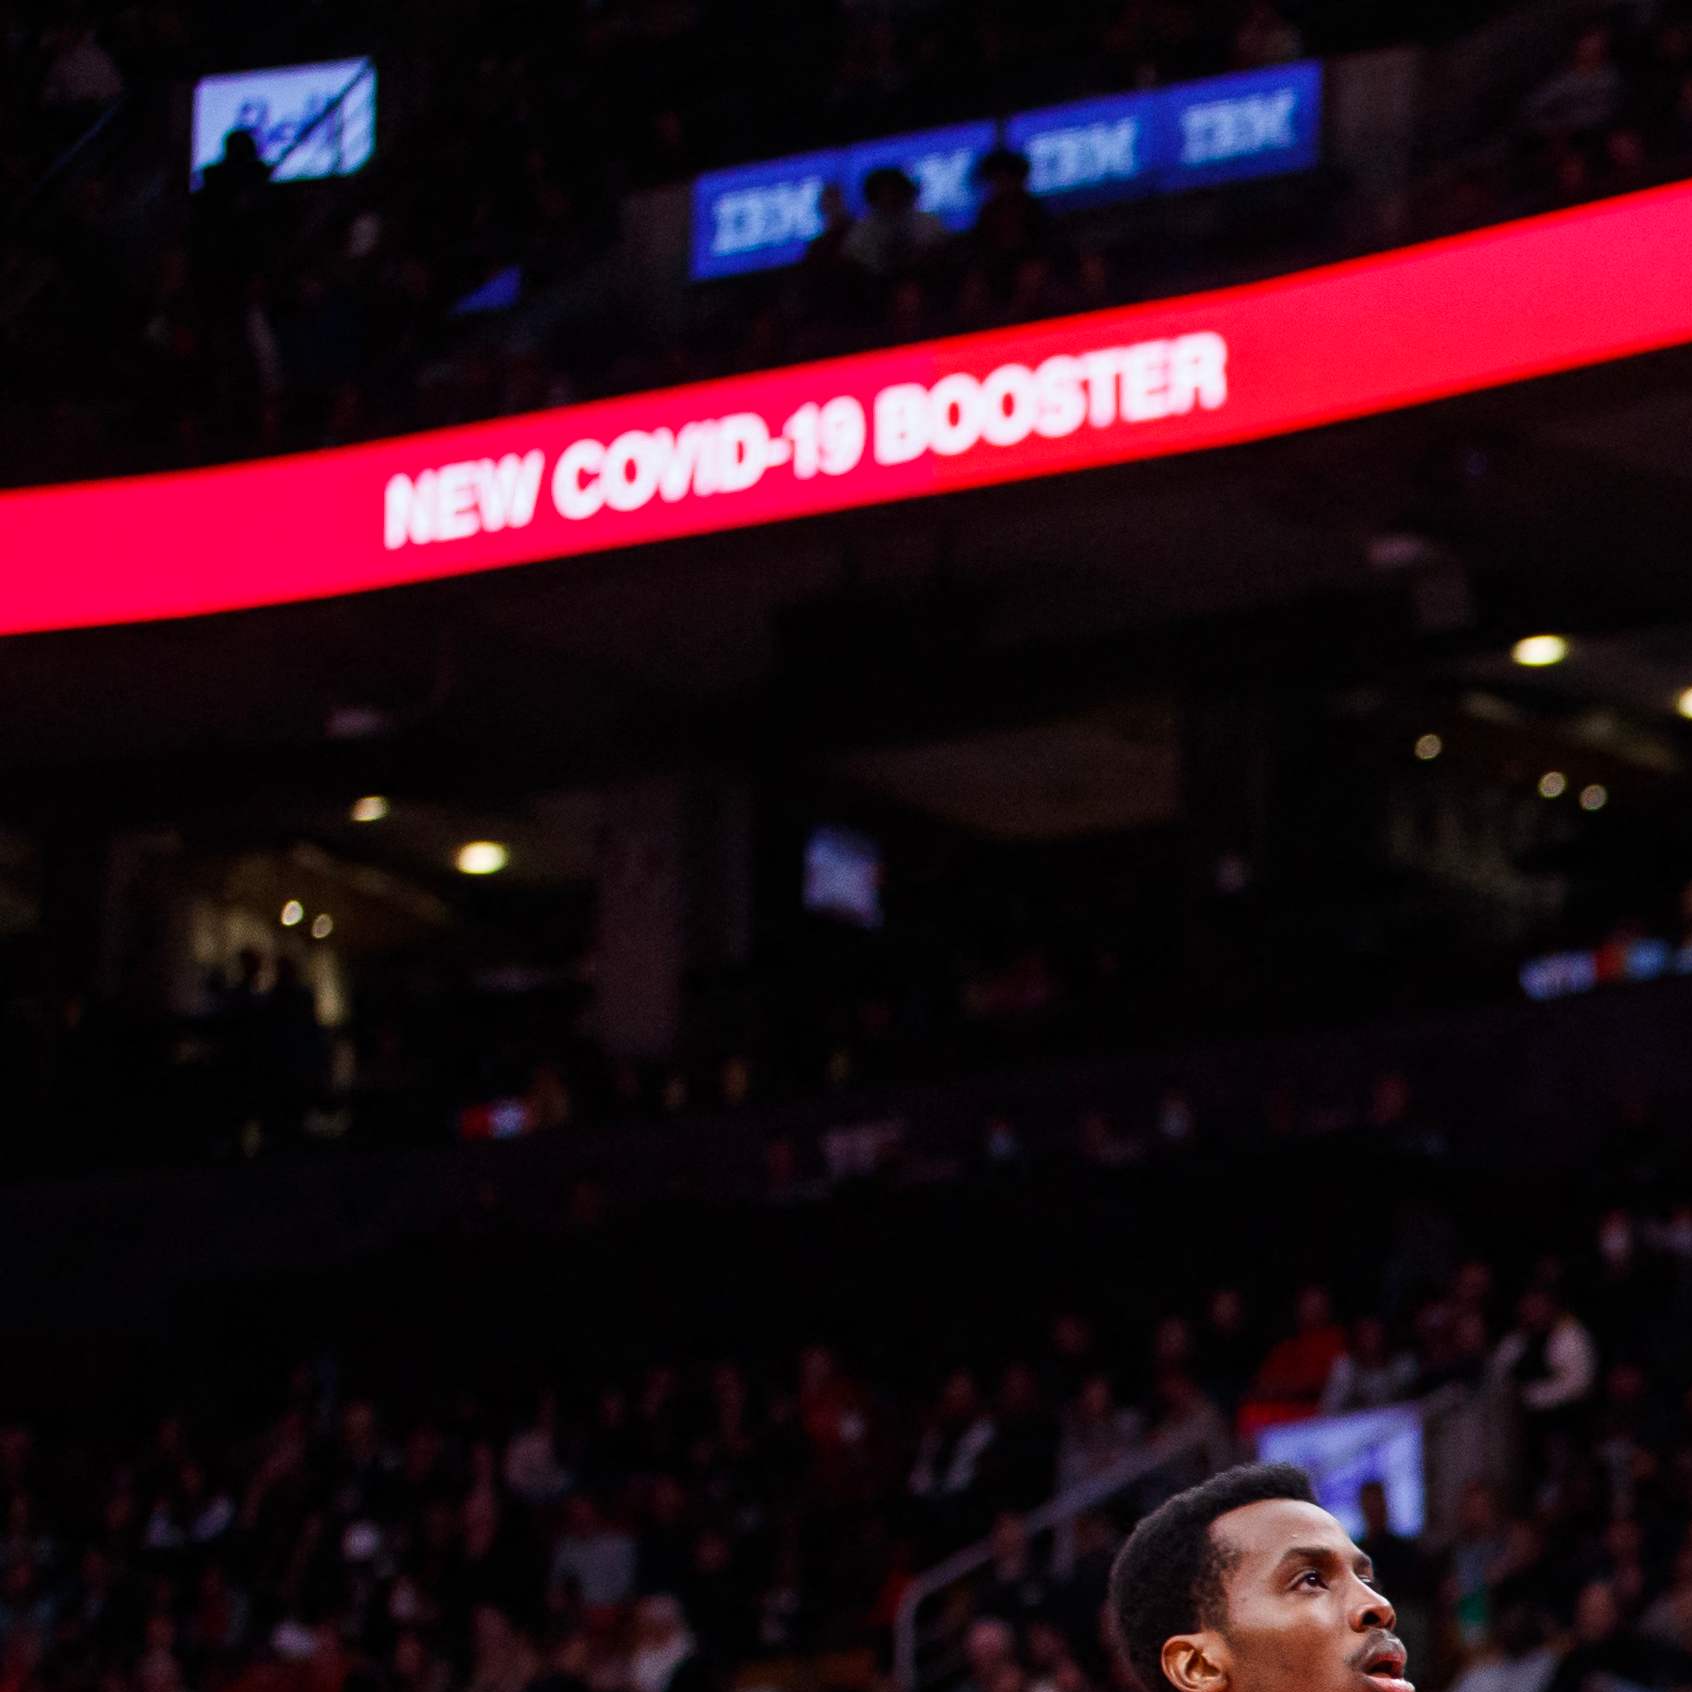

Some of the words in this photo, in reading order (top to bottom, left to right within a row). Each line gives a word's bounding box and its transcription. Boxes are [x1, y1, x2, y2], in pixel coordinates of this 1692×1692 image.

[384, 449, 544, 550] NEW
[551, 396, 866, 520] COVID-19
[873, 331, 1229, 463] BOOSTER
